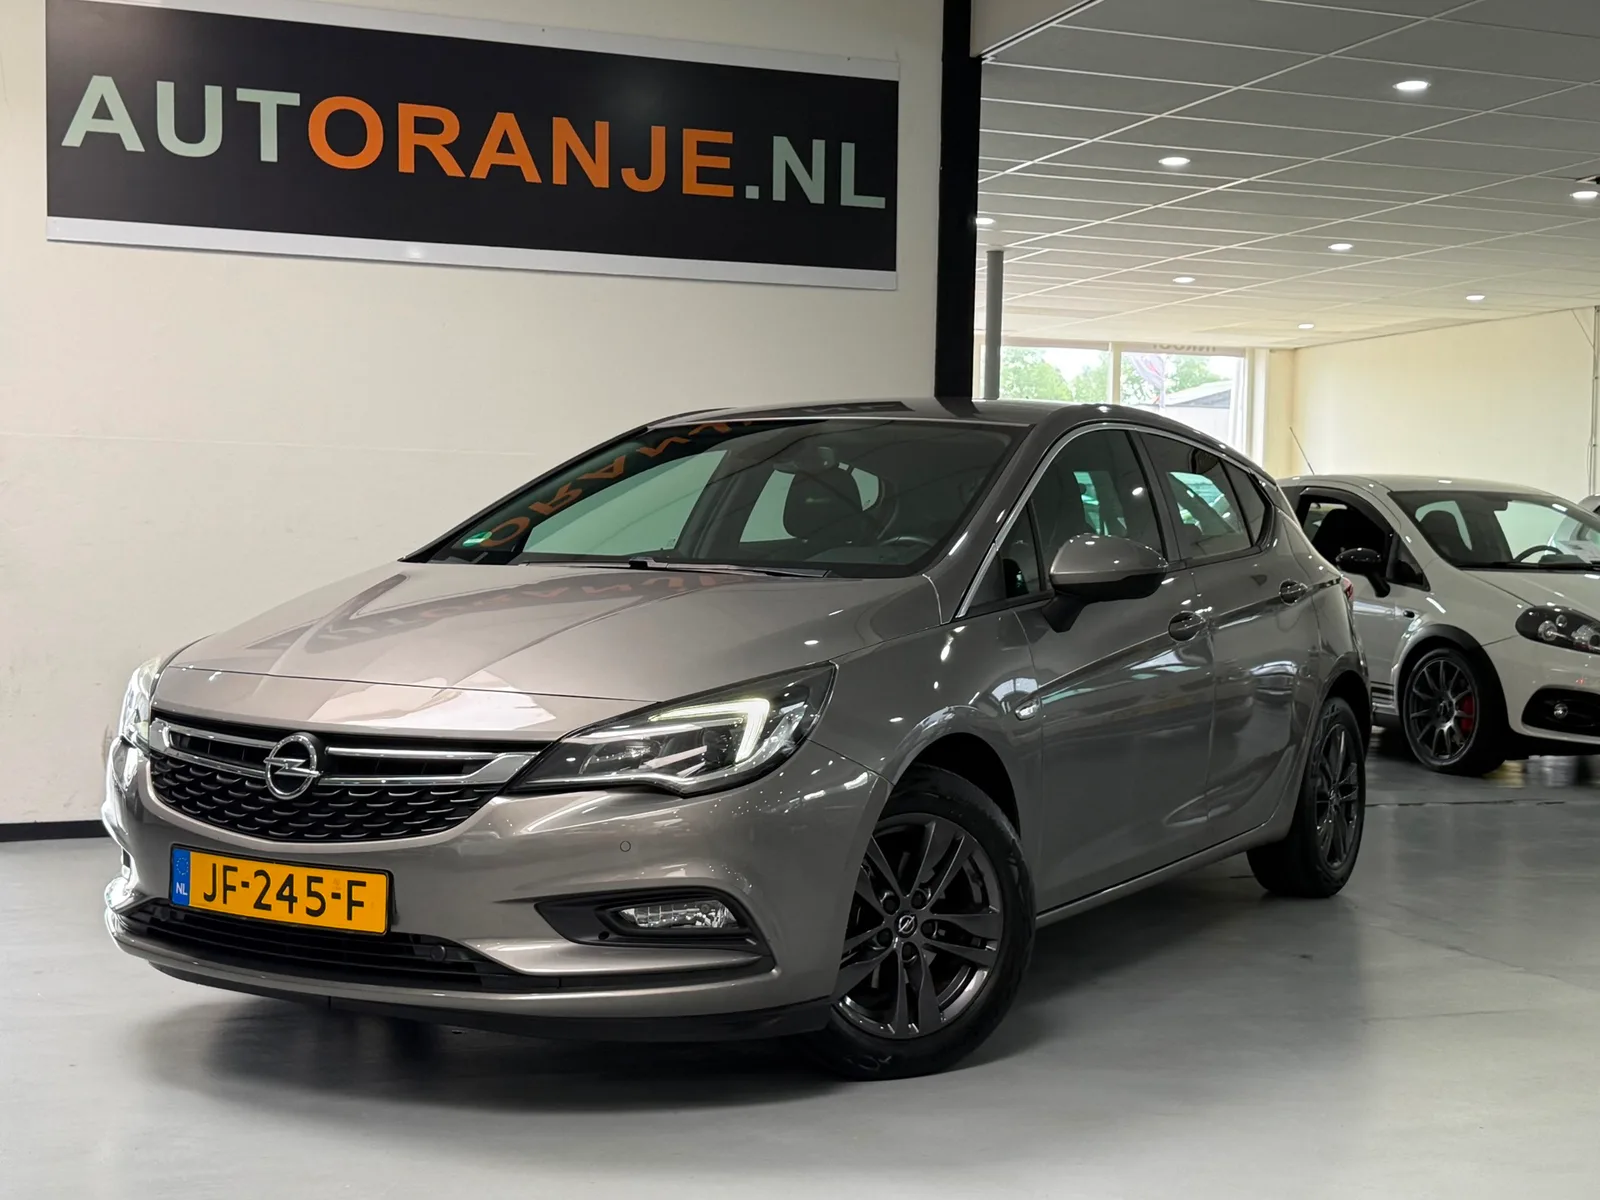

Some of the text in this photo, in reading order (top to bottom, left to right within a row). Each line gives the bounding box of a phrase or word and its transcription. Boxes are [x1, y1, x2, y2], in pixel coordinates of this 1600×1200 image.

[61, 74, 887, 210] AUTORANJE.NL
[175, 881, 188, 896] NL
[203, 862, 367, 921] JF-245-F
